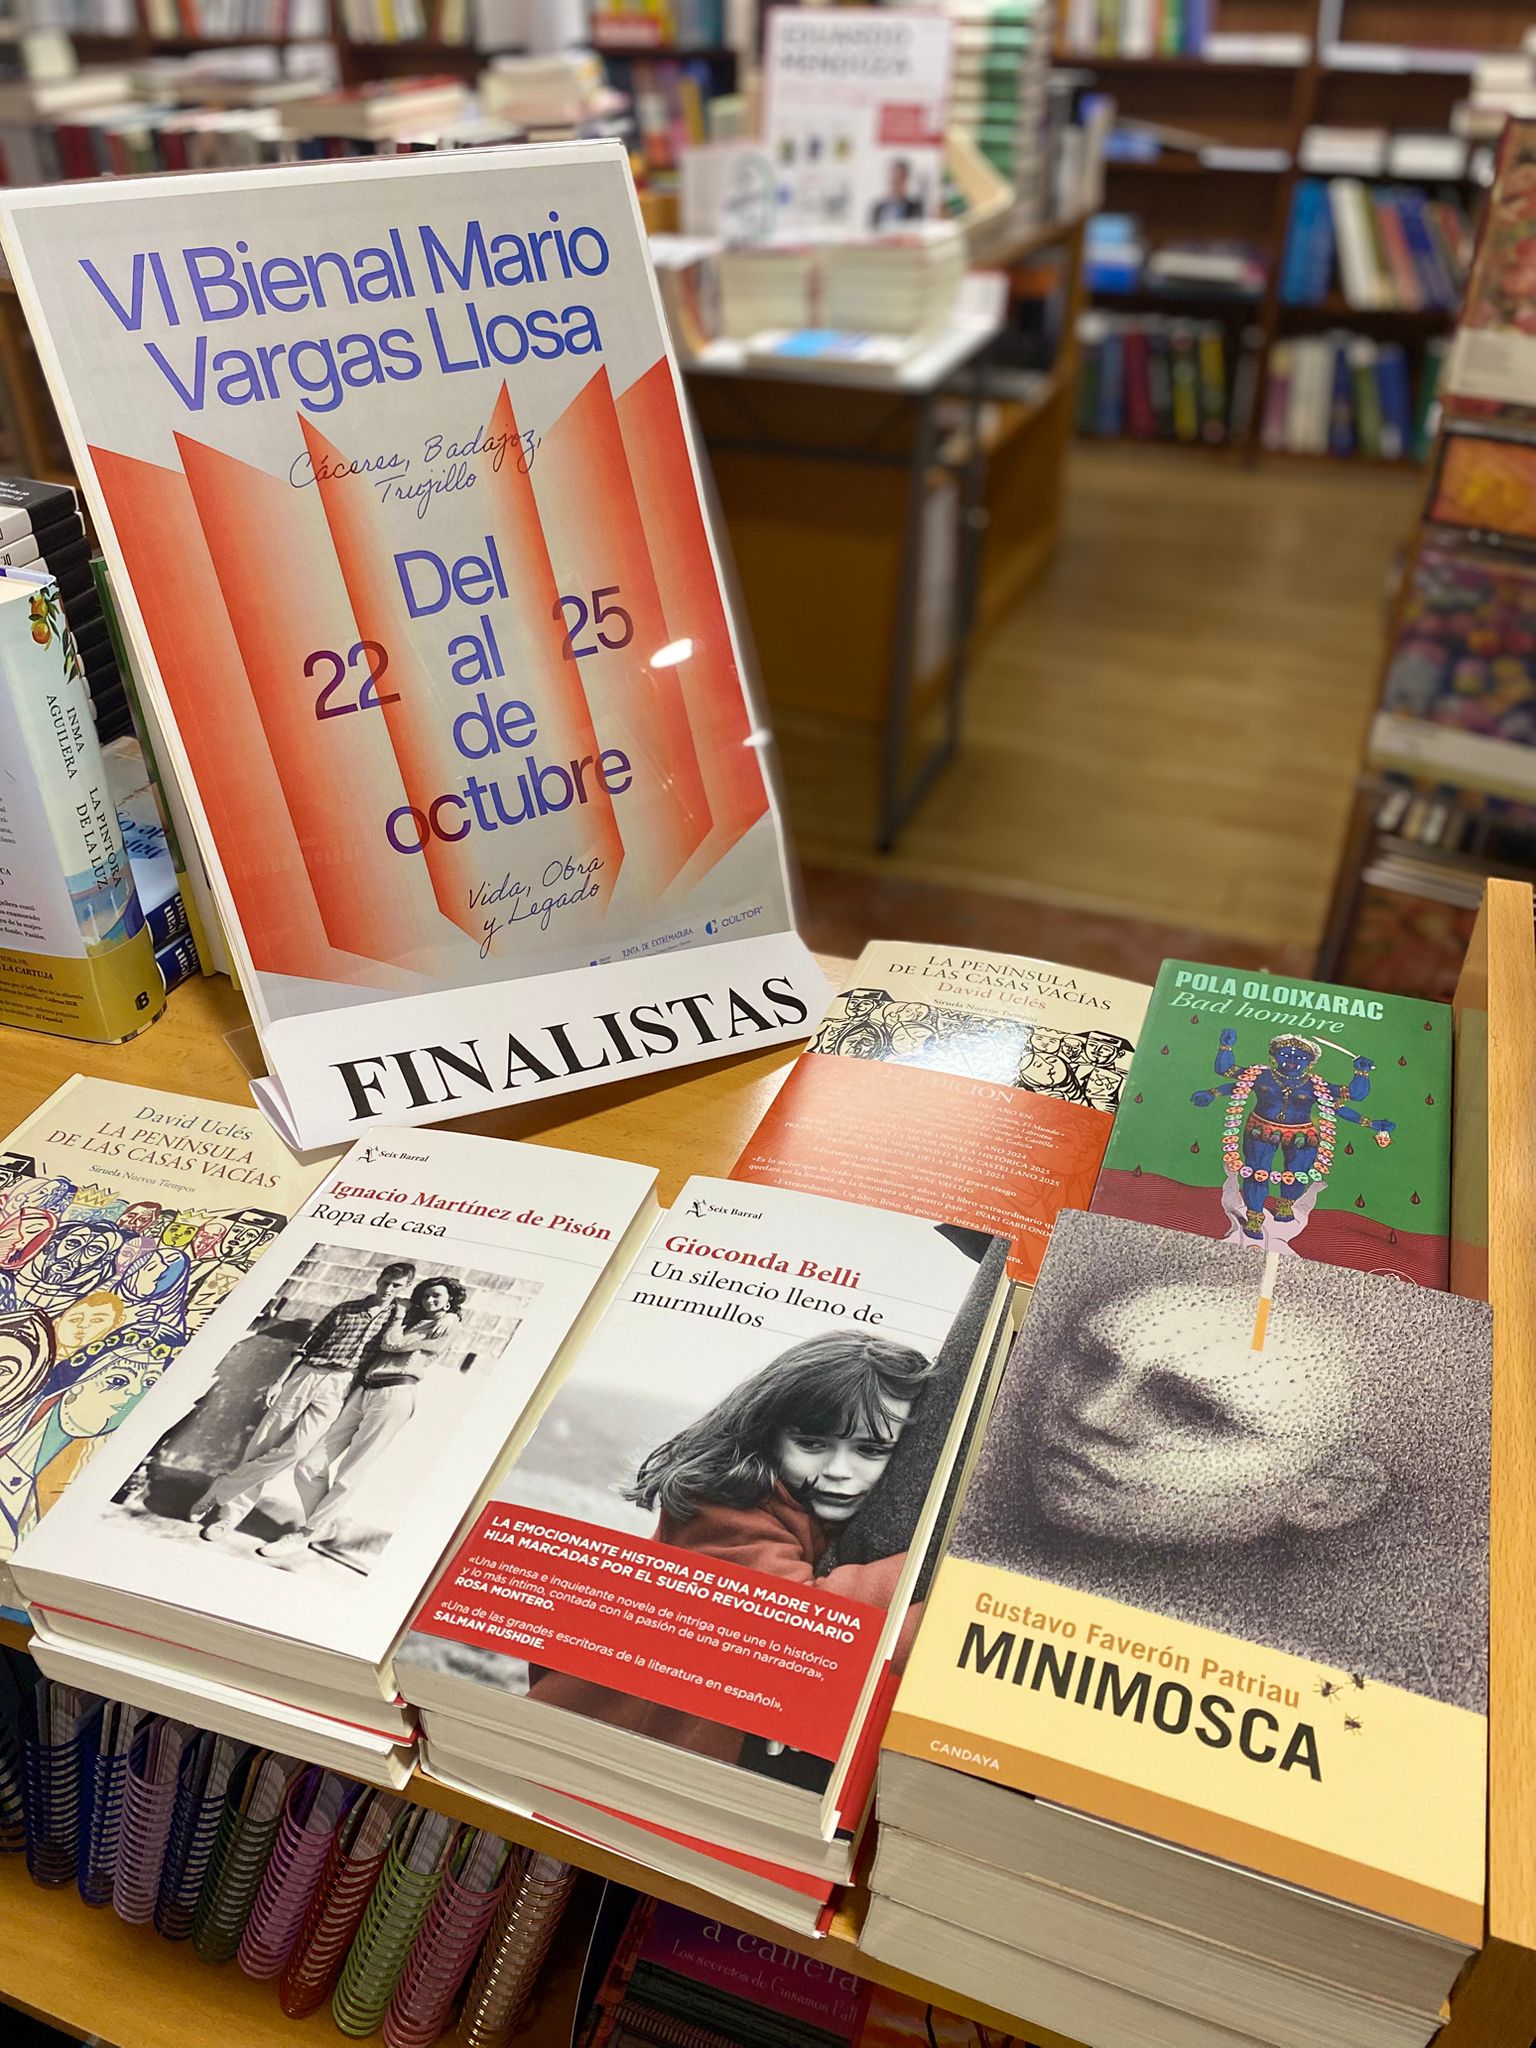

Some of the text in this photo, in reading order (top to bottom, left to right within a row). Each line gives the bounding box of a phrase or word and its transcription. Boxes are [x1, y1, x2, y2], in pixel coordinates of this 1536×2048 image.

[78, 211, 609, 332] VI Bienal Mario
[143, 302, 602, 413] Vargas Llosa
[290, 431, 542, 489] Cáceres, Badajoz,
[376, 472, 477, 519] Trujillo
[394, 536, 508, 619] Del
[304, 586, 633, 721] 22 al 25
[46, 695, 77, 779] AGUILERA
[67, 707, 84, 752] INMA
[453, 693, 538, 761] de
[386, 747, 633, 855] octubre
[76, 803, 108, 889] DE LA LUZ
[89, 787, 121, 888] LA PINTORA
[468, 857, 605, 910] Vida, Obra
[480, 874, 600, 959] y Legado
[652, 928, 693, 948] EXTREMADURA
[889, 964, 1111, 1011] DE LAS CASAS VACÍAS
[928, 956, 1077, 989] LA PENÍNSULA
[938, 981, 1047, 1009] David Uclés
[1175, 971, 1384, 1020] POLA OLOIXARAC
[1169, 991, 1345, 1033] Bad hombre
[330, 976, 808, 1121] FINALISTAS
[98, 1122, 253, 1164] LA PENÍNSULA
[135, 1106, 253, 1140] David Uclés
[46, 1130, 280, 1188] DE LAS CASAS VACÍAS
[378, 1150, 429, 1162] Seix Barral
[976, 1161, 1060, 1186] CASTELLANO 2025
[1006, 1151, 1026, 1159] 2024
[1030, 1165, 1050, 1175] 2025
[122, 1171, 156, 1185] Nuevos
[160, 1177, 196, 1193] Tiempos
[310, 1203, 447, 1237] Ropa de casa
[330, 1181, 611, 1240] Ignacio Martínez de Pisón
[708, 1204, 762, 1220] Seix Barral
[979, 1204, 1042, 1225] extraordinario
[665, 1235, 861, 1289] Gioconda Belli
[632, 1289, 764, 1328] murmullos
[650, 1261, 883, 1325] Un silencio lleno de
[455, 1576, 554, 1610] ROSA MONTERO.
[484, 1529, 854, 1643] HIJA MARCADAS POR EL SUEÑO REVOLUCIONARIO
[492, 1516, 860, 1629] LA EMOCIONANTE HISTORIA DE UNA MADRE Y UNA
[433, 1610, 544, 1649] SALMAN RUSHDIE.
[460, 1567, 824, 1681] y lo más íntimo, contada con la pasión de una gran narradora»,
[469, 1556, 838, 1670] «Una intensa e inquietante novela de intriga que une lo histórico
[441, 1600, 782, 1711] «Una de las grandes escritoras de la literatura en español»,
[975, 1592, 1299, 1708] Gustavo Faverón Patriau
[957, 1622, 1322, 1782] MINIMOSCA
[930, 1739, 1000, 1770] CANDAYA
[702, 1921, 721, 1942] a
